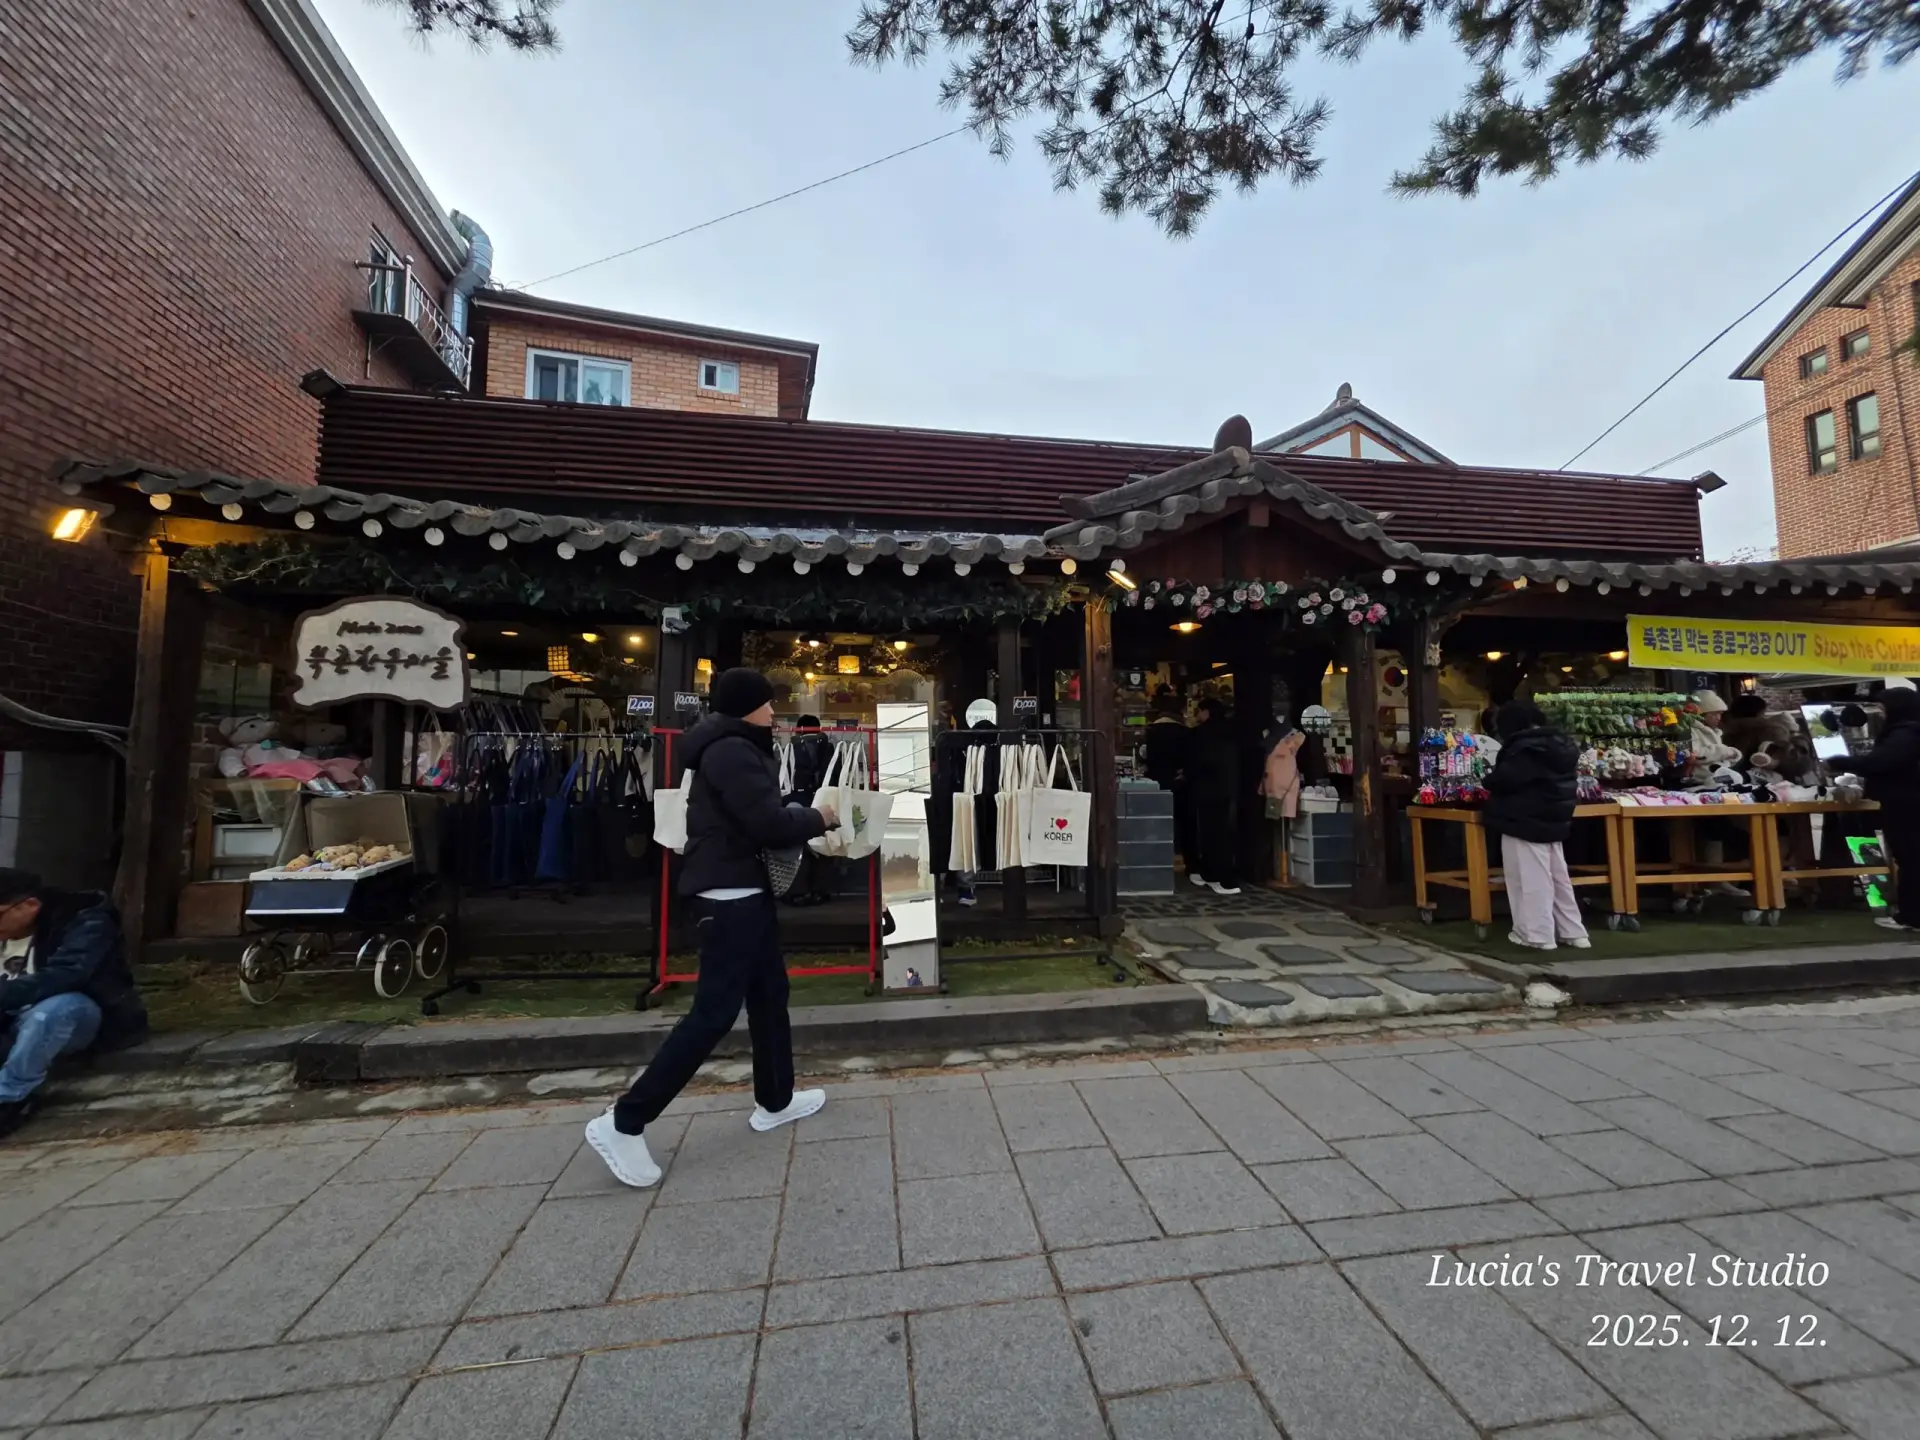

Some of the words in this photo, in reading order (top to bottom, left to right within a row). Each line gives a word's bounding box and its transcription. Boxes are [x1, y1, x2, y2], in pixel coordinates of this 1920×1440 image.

[1643, 626, 1683, 653] 북촌길
[1685, 629, 1709, 654] 막는
[1712, 629, 1772, 656] 종로구청장
[1774, 632, 1807, 656] OUT
[1814, 634, 1848, 664] Stop
[1850, 636, 1874, 660] the
[1696, 676, 1708, 688] 51
[1013, 699, 1036, 711] 10,000
[1050, 817, 1054, 828] I
[1044, 832, 1073, 842] KOREA
